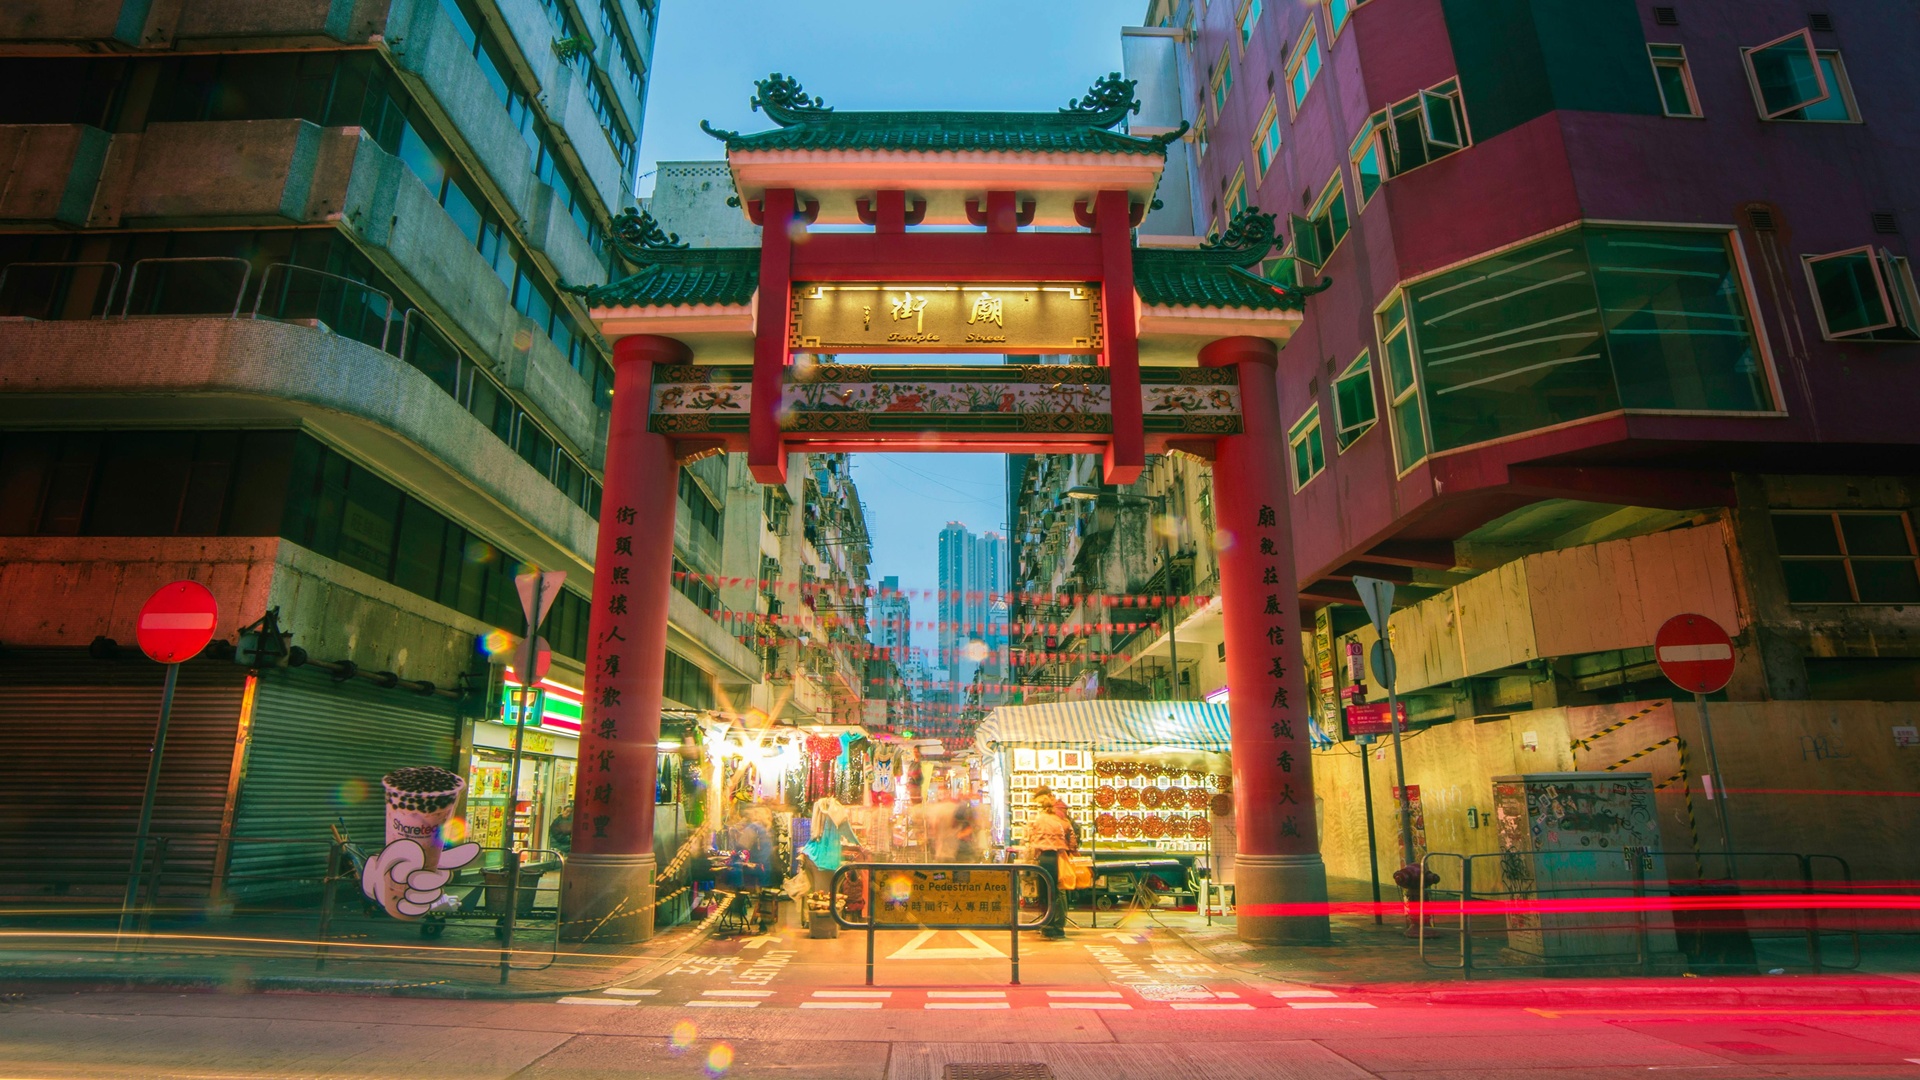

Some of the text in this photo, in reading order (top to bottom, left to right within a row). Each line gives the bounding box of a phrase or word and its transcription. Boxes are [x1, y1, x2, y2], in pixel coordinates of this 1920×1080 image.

[887, 332, 1006, 344] Temple Street
[928, 882, 981, 892] Pedestrian
[985, 882, 1007, 892] Area
